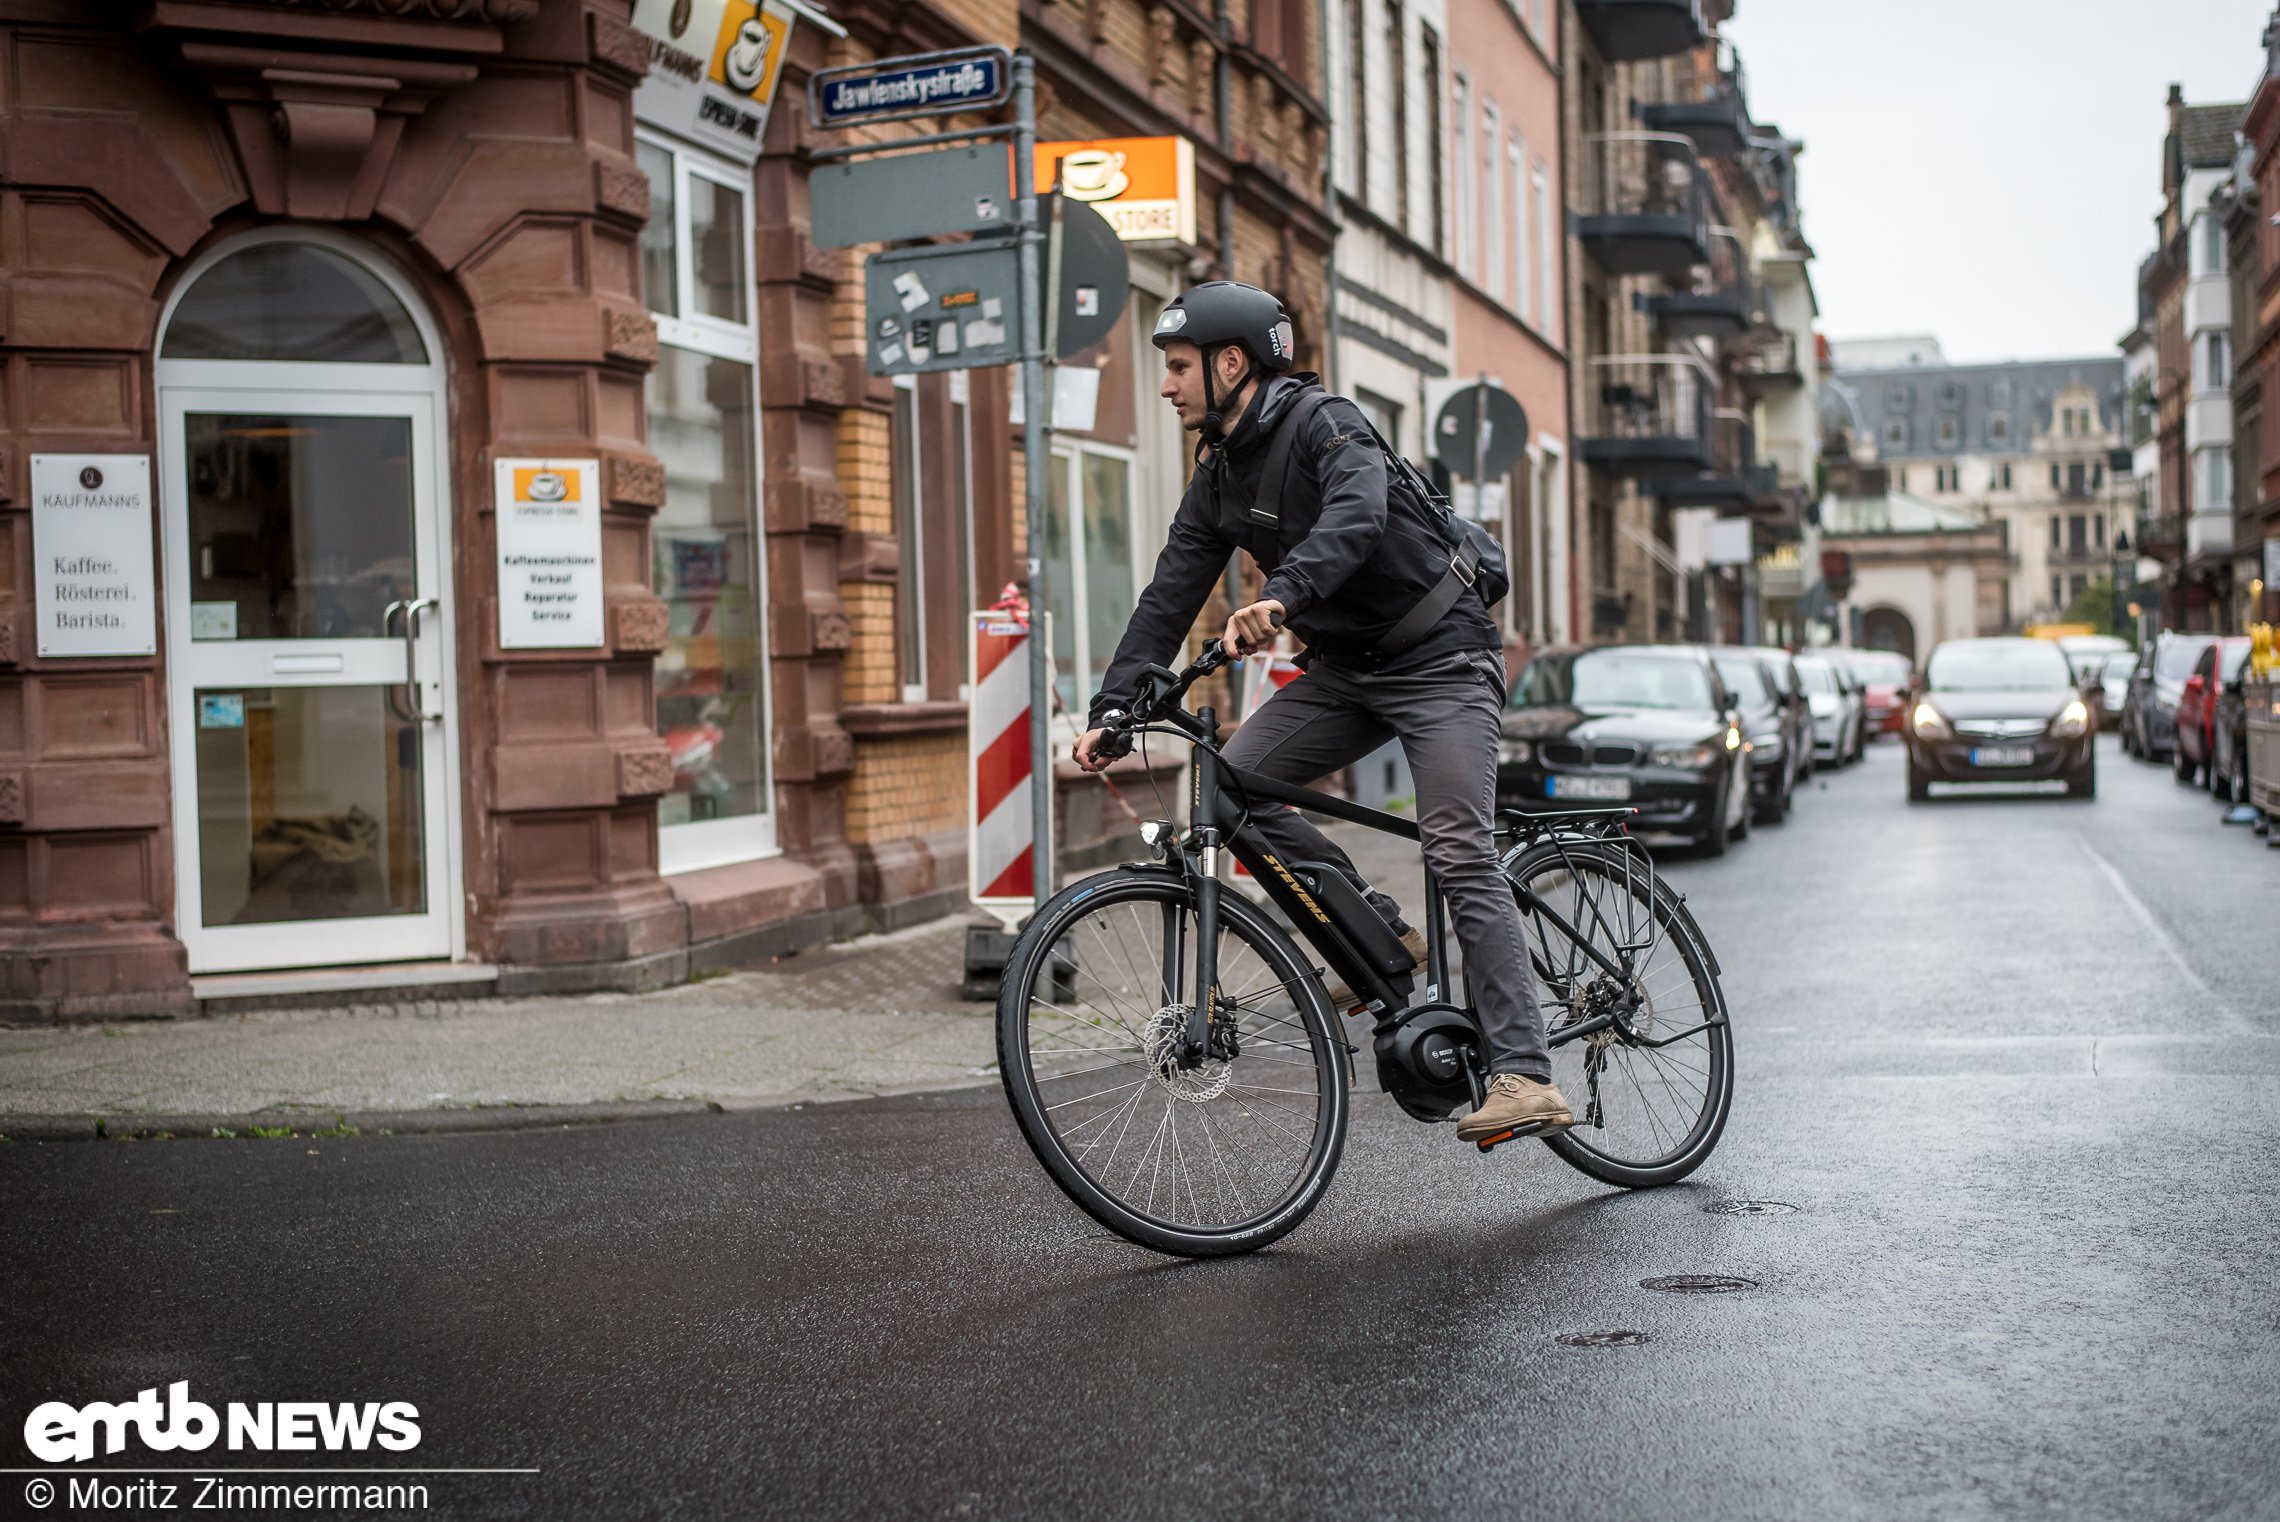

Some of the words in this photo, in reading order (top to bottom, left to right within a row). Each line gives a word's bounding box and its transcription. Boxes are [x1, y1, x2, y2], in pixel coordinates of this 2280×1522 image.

[832, 64, 985, 110] Jawlenskystraße
[1115, 208, 1172, 231] STORE
[1268, 327, 1281, 356] torch
[43, 493, 141, 508] KAUFMANNS
[54, 556, 118, 576] Kaffee.
[503, 554, 595, 566] Kaffeemaschinen
[530, 574, 571, 584] Verkauf
[55, 581, 137, 602] Rösterei.
[524, 592, 577, 605] Reparatur
[56, 610, 127, 630] Barista.
[531, 610, 570, 621] Service
[1262, 853, 1332, 924] STEVENS
